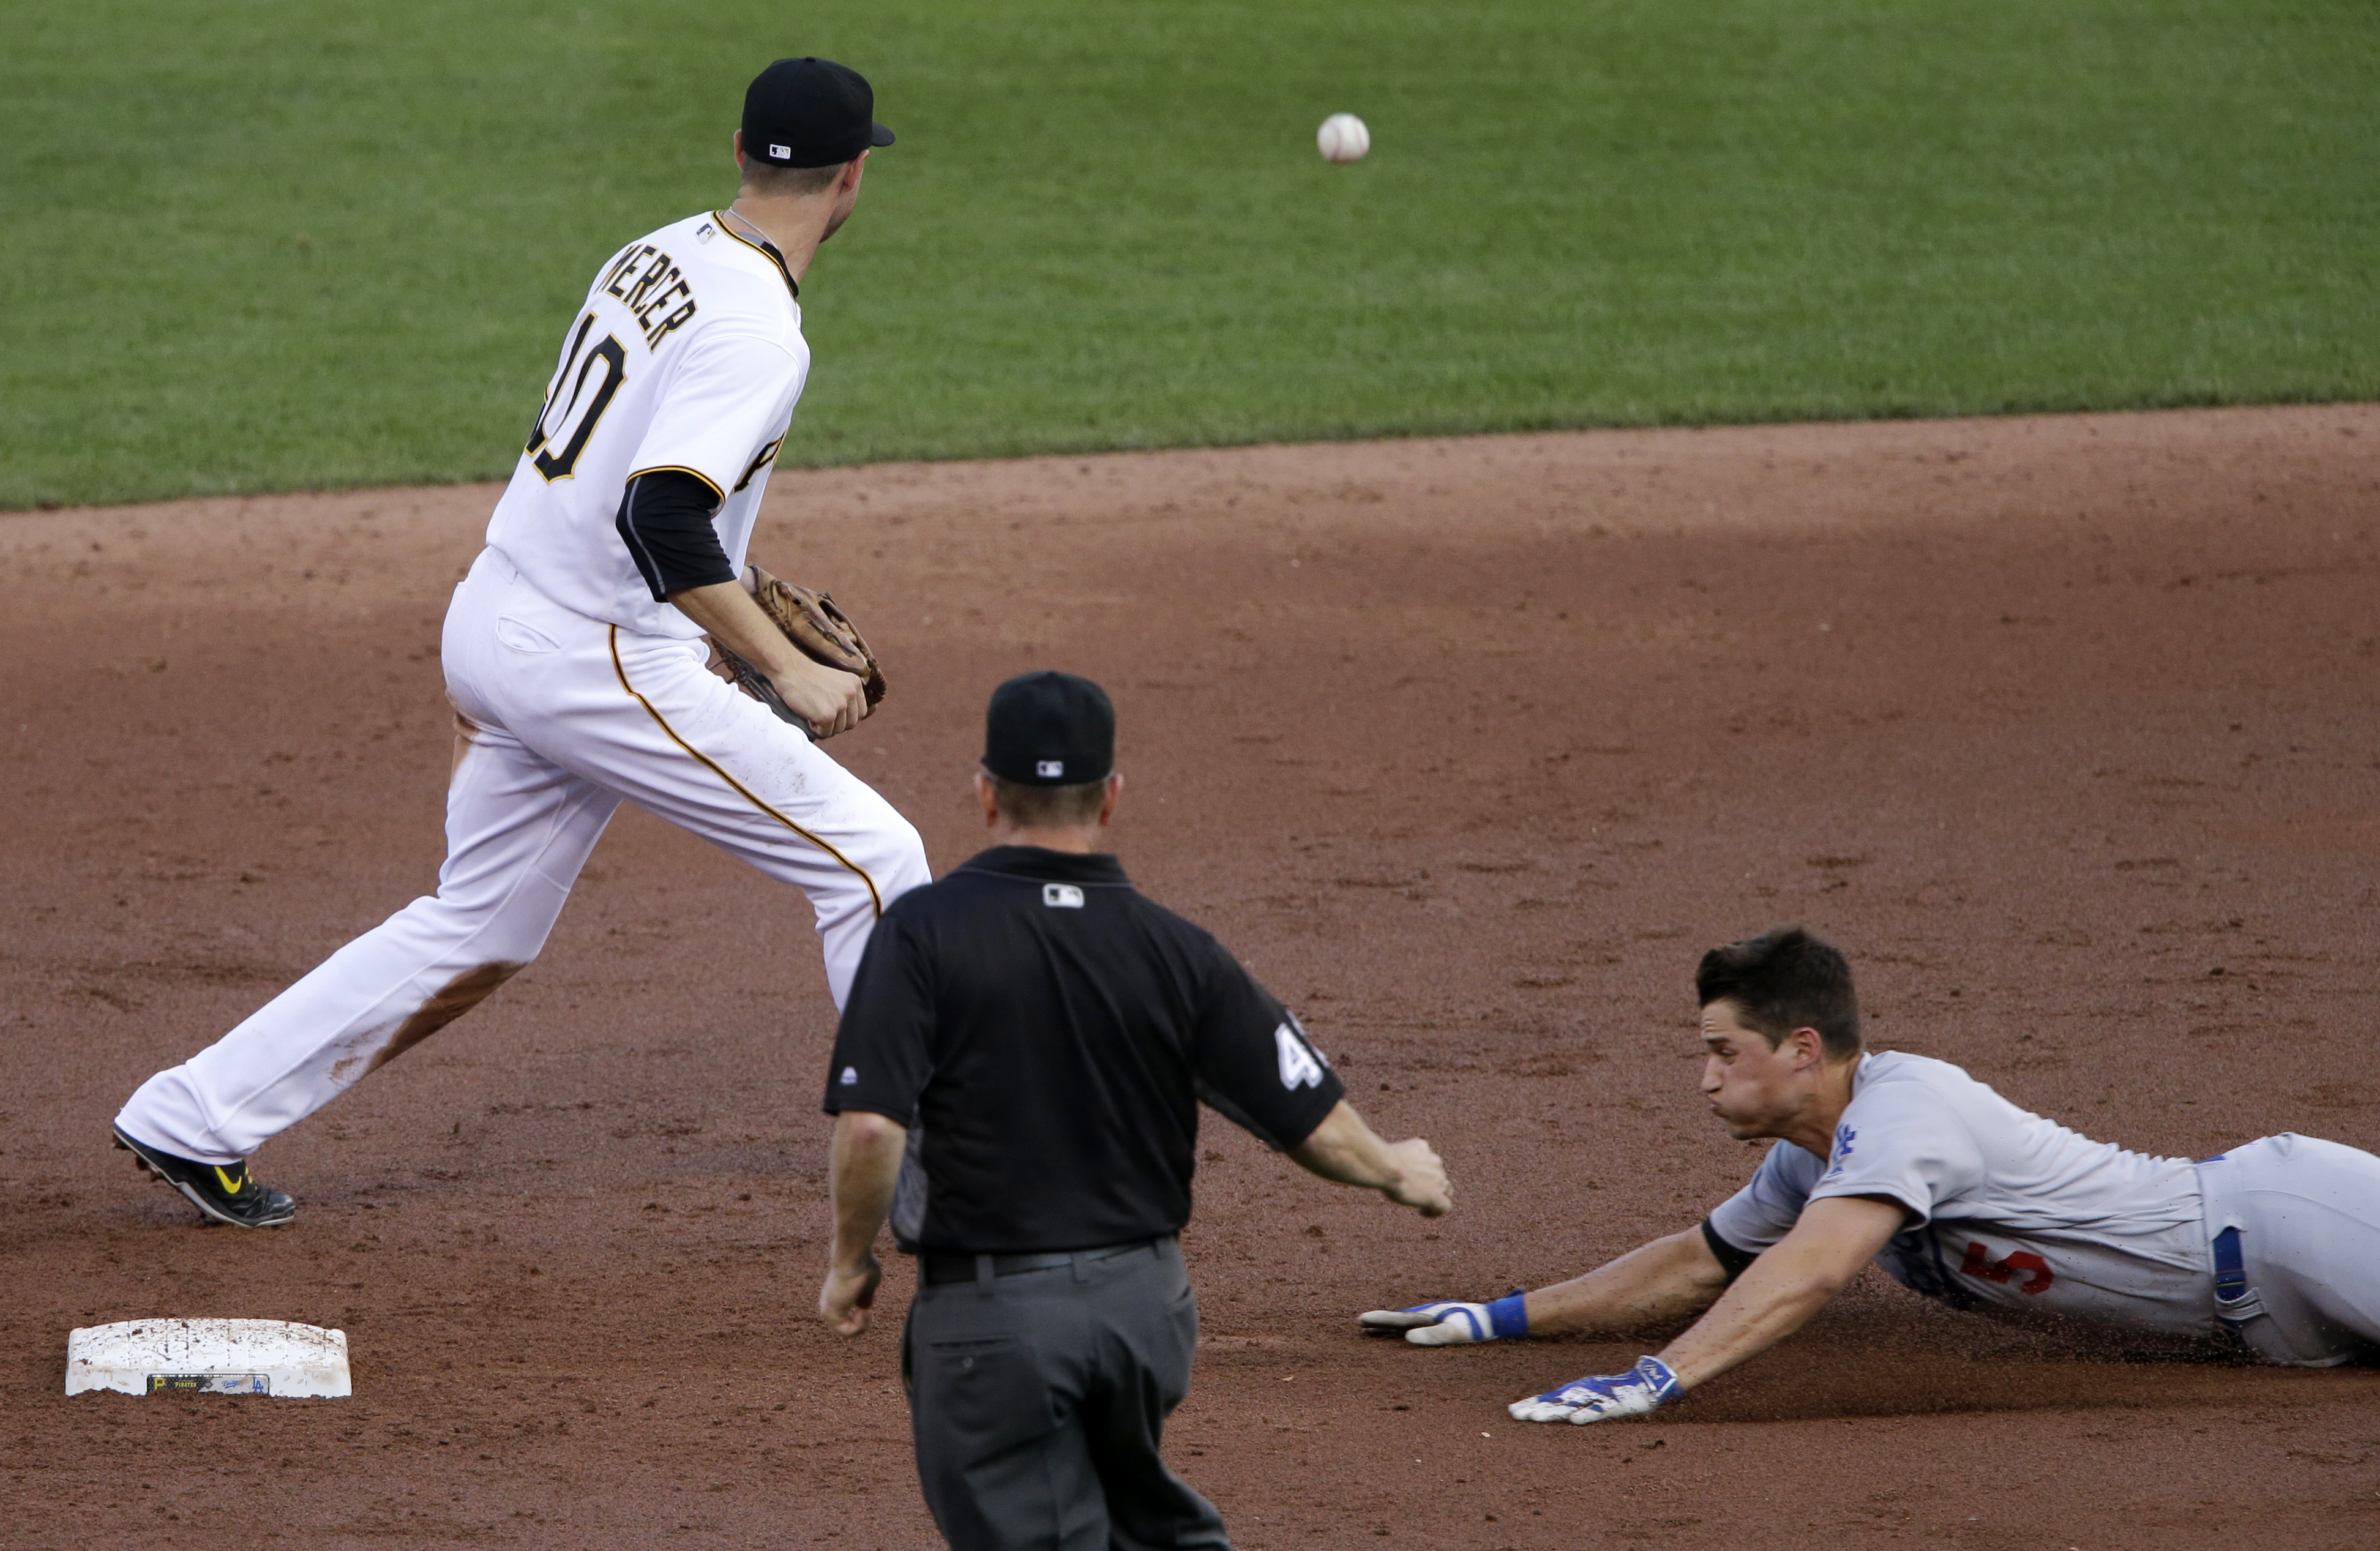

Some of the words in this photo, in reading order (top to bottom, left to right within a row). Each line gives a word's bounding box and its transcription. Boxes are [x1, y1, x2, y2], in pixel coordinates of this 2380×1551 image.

[524, 310, 628, 485] 10
[1959, 1241, 2054, 1296] 5
[252, 1377, 264, 1394] LA
